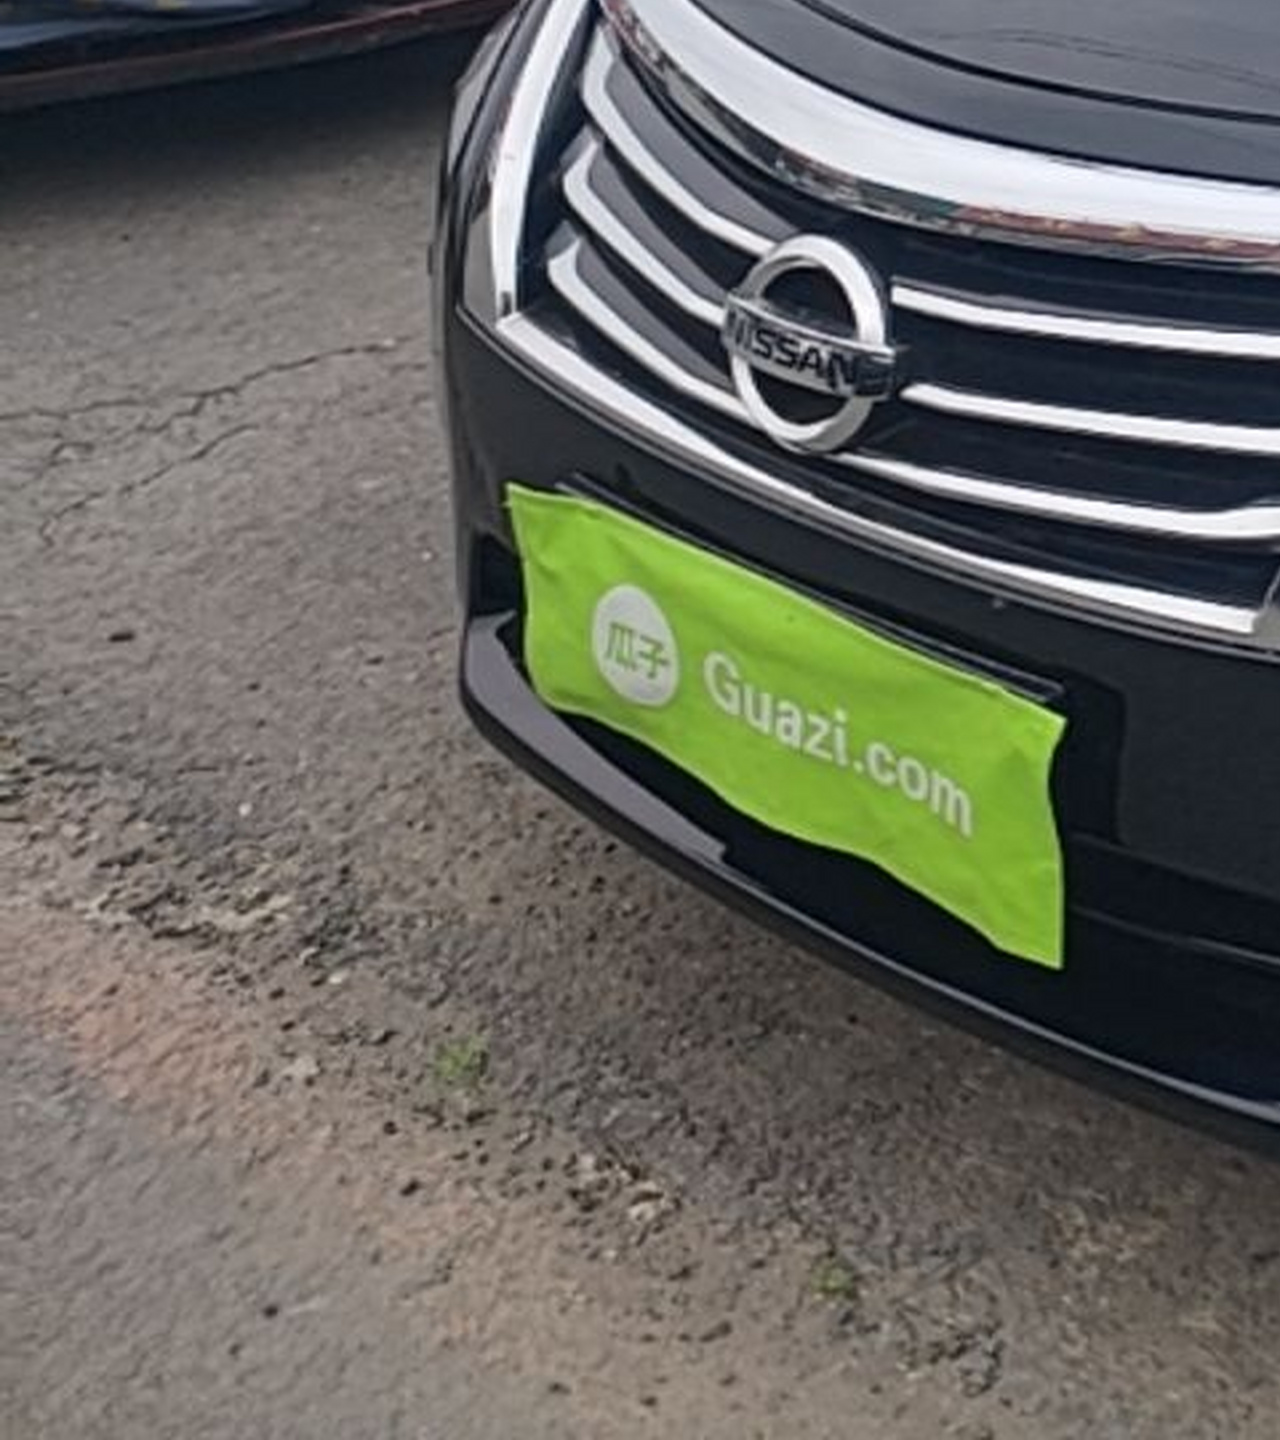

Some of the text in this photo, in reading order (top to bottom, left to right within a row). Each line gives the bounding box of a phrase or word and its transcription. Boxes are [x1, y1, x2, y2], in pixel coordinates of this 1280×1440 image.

[725, 309, 857, 396] NISSAN
[604, 621, 669, 679] 瓜子
[703, 650, 974, 838] Guazi.com
